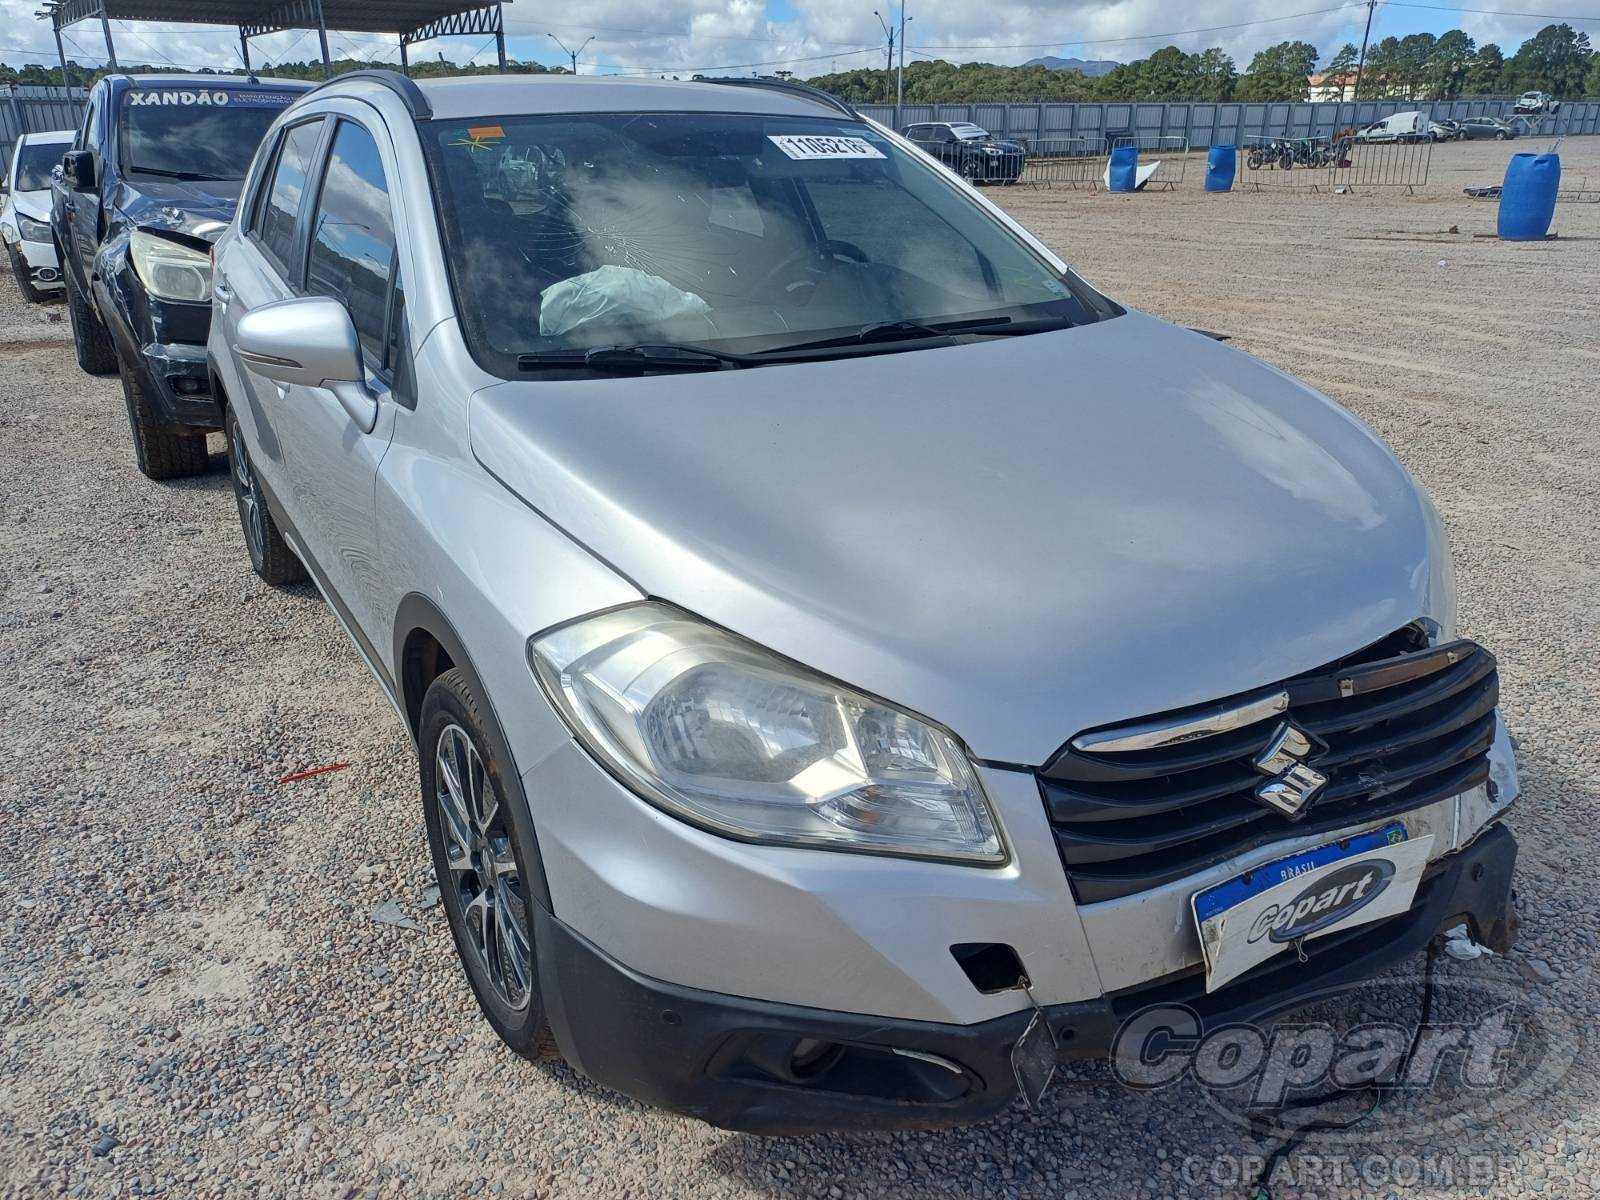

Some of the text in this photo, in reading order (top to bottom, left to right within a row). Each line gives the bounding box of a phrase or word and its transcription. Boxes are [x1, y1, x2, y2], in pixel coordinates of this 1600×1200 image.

[130, 89, 229, 106] XANDÃO
[787, 137, 867, 154] 1105218
[1248, 869, 1375, 943] Copart
